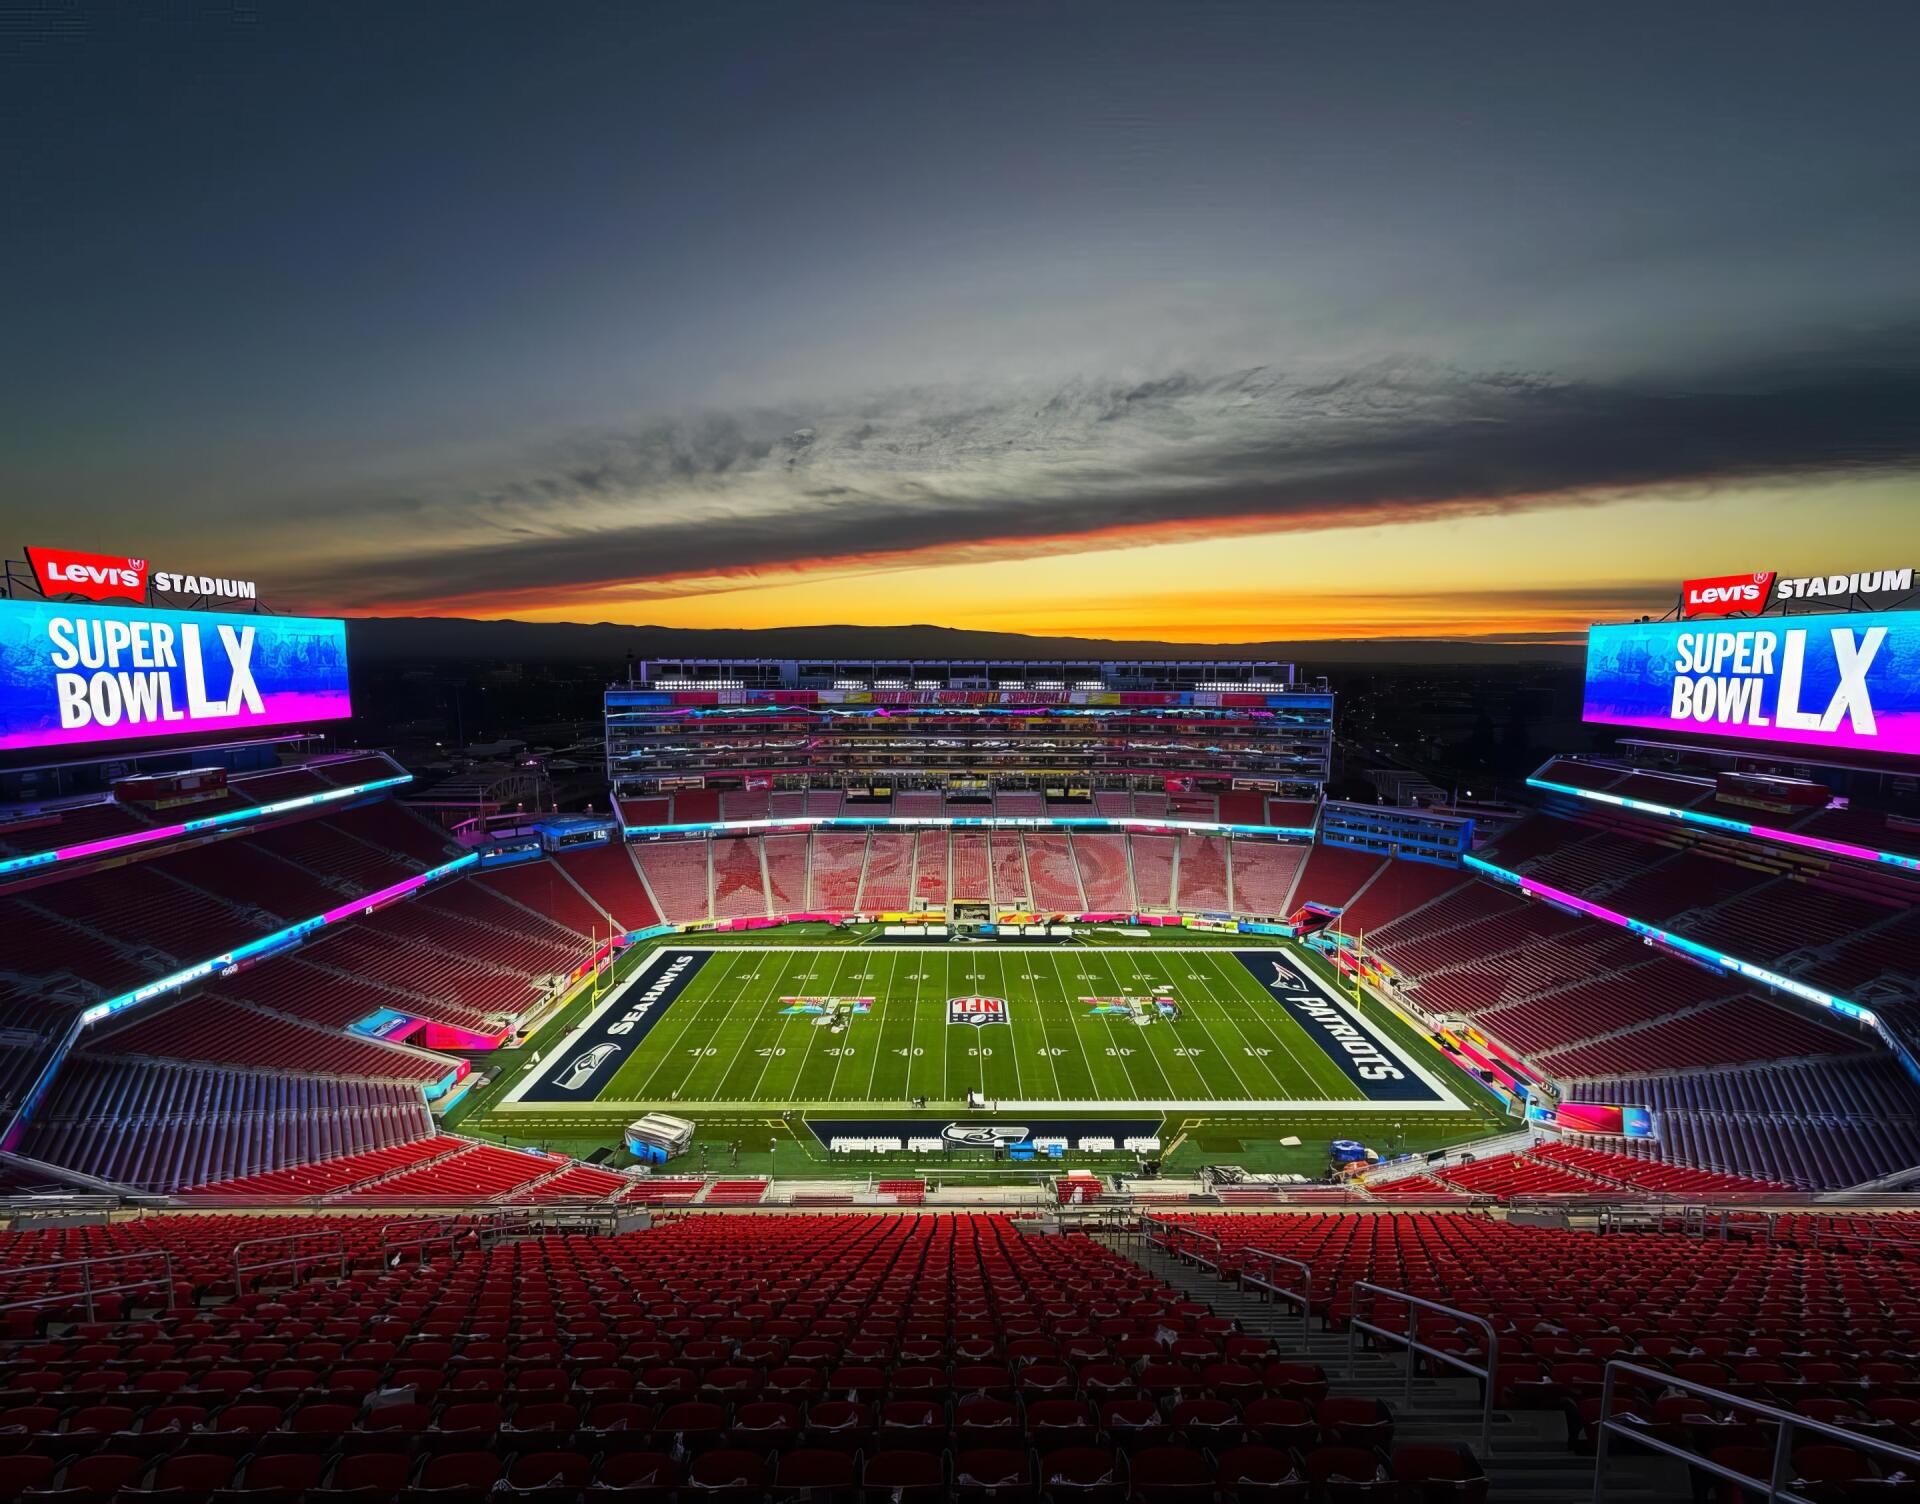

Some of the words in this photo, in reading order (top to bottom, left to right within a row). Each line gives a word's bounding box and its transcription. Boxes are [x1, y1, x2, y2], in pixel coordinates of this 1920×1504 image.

[154, 572, 256, 599] STADIUM
[1777, 568, 1913, 600] STADIUM
[48, 617, 177, 669] SUPER
[1675, 631, 1778, 674] SUPER
[181, 623, 266, 719] LX
[1775, 627, 1888, 735] LX
[56, 671, 184, 729] BOWL
[1670, 676, 1770, 727] BOWL
[607, 955, 694, 1035] SEAHAWKS
[954, 998, 1000, 1013] NFL
[1285, 997, 1405, 1080] PATRIOTS
[691, 1047, 718, 1057] 10
[759, 1047, 787, 1057] 20
[829, 1047, 856, 1057] 30
[899, 1047, 924, 1057] 40
[968, 1047, 993, 1057] 50
[1037, 1047, 1063, 1057] 40
[1105, 1047, 1131, 1057] 30
[1173, 1047, 1200, 1057] 20
[1244, 1047, 1270, 1057] 10
